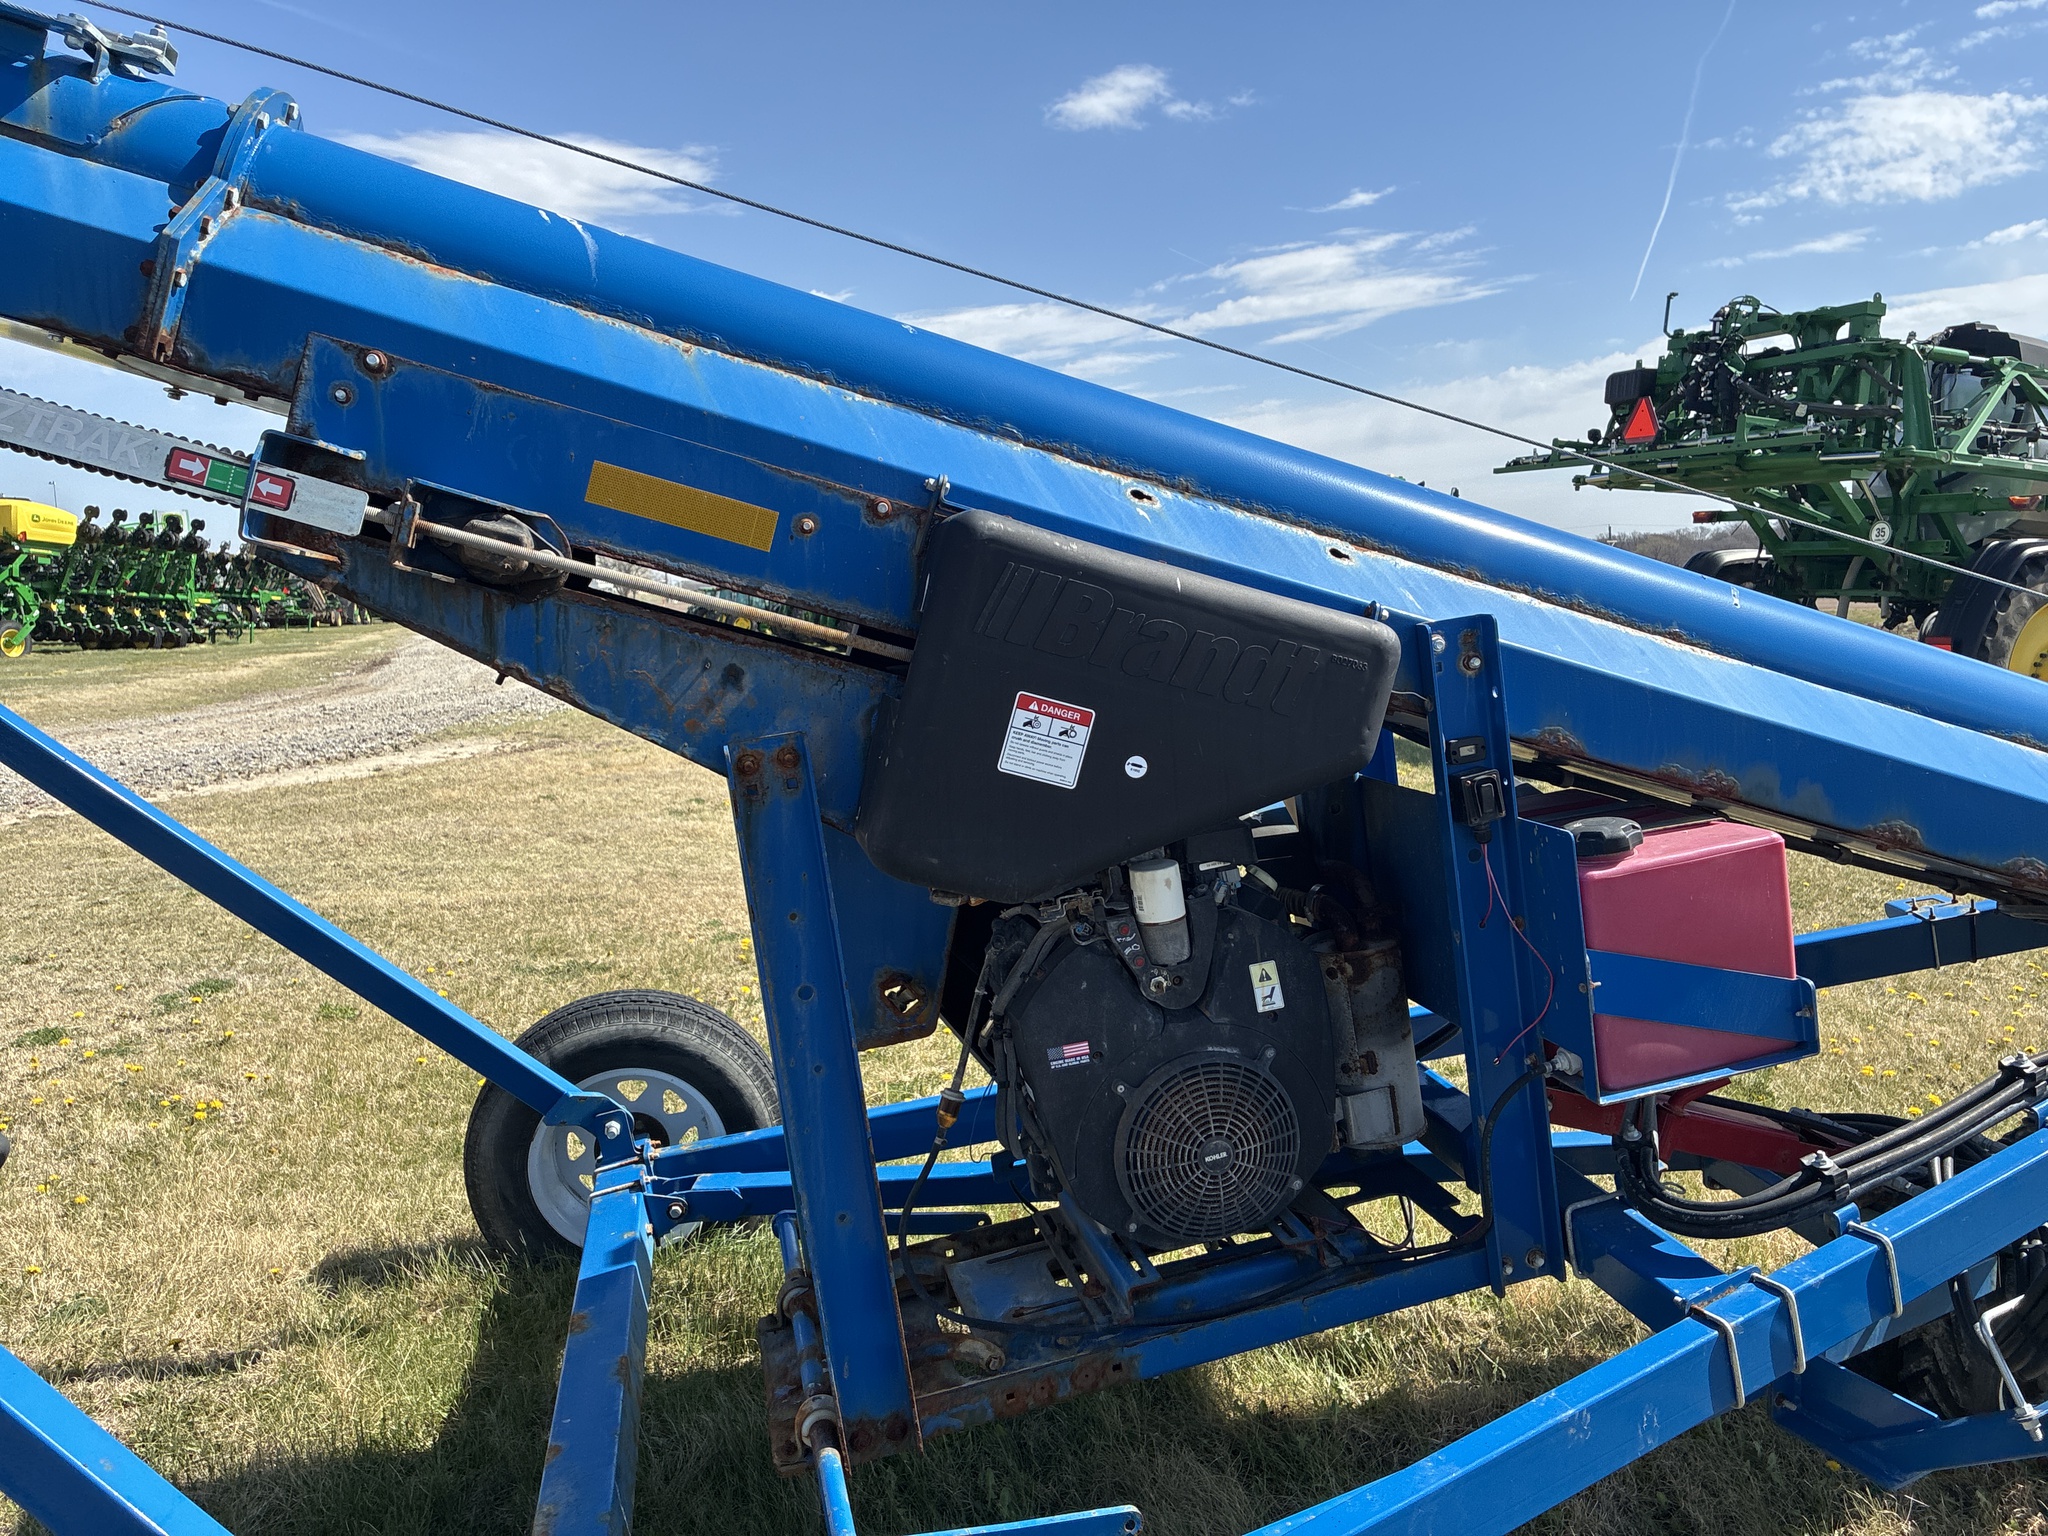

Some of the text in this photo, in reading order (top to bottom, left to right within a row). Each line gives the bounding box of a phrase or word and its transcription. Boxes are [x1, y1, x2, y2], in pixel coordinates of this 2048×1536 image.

[1875, 526, 1885, 537] 35
[1033, 578, 1321, 717] Brandt
[1040, 703, 1081, 721] DANGER
